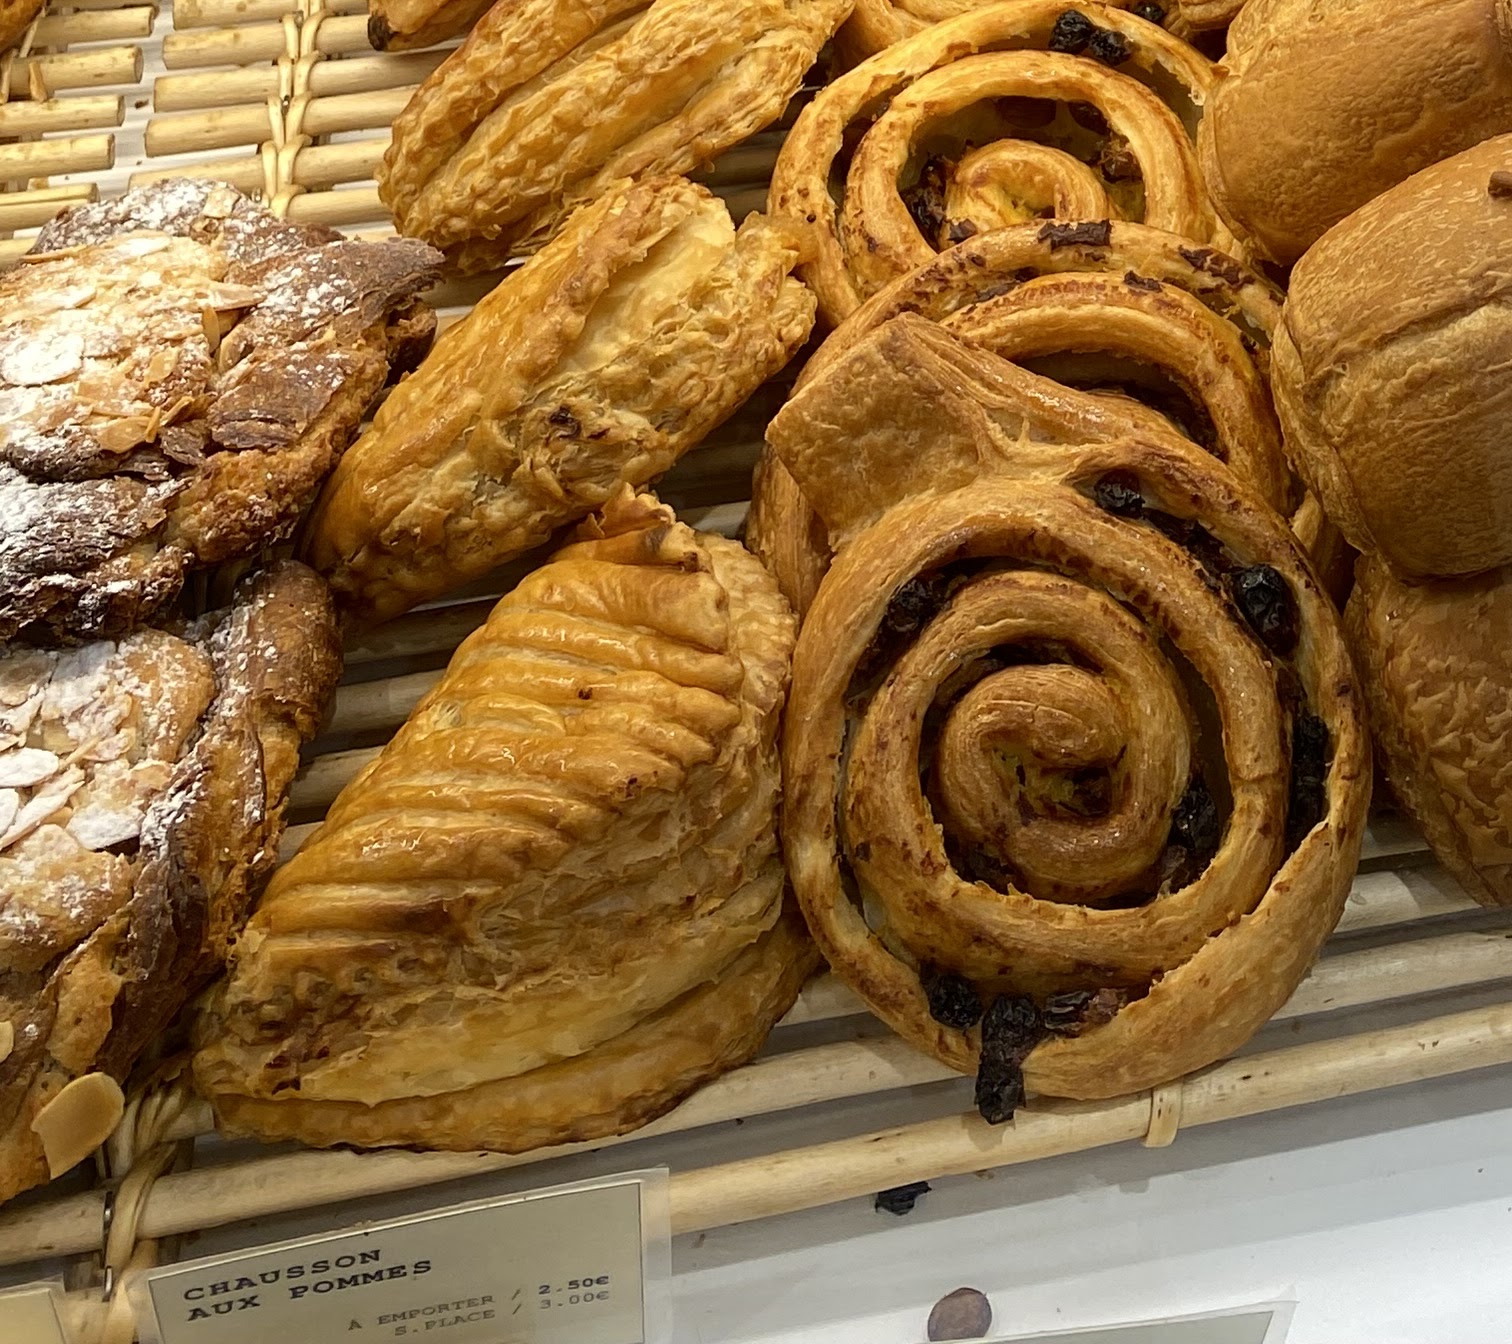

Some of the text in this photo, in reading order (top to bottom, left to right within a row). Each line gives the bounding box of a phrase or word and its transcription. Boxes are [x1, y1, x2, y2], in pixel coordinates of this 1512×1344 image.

[184, 1249, 382, 1301] CHAUSSON
[186, 1260, 432, 1322] AUX POMMES
[377, 1294, 495, 1326] EMPORTER
[538, 1274, 610, 1296] 2.50€
[394, 1309, 496, 1337] S.PLACE
[539, 1290, 610, 1311] 3.00€
